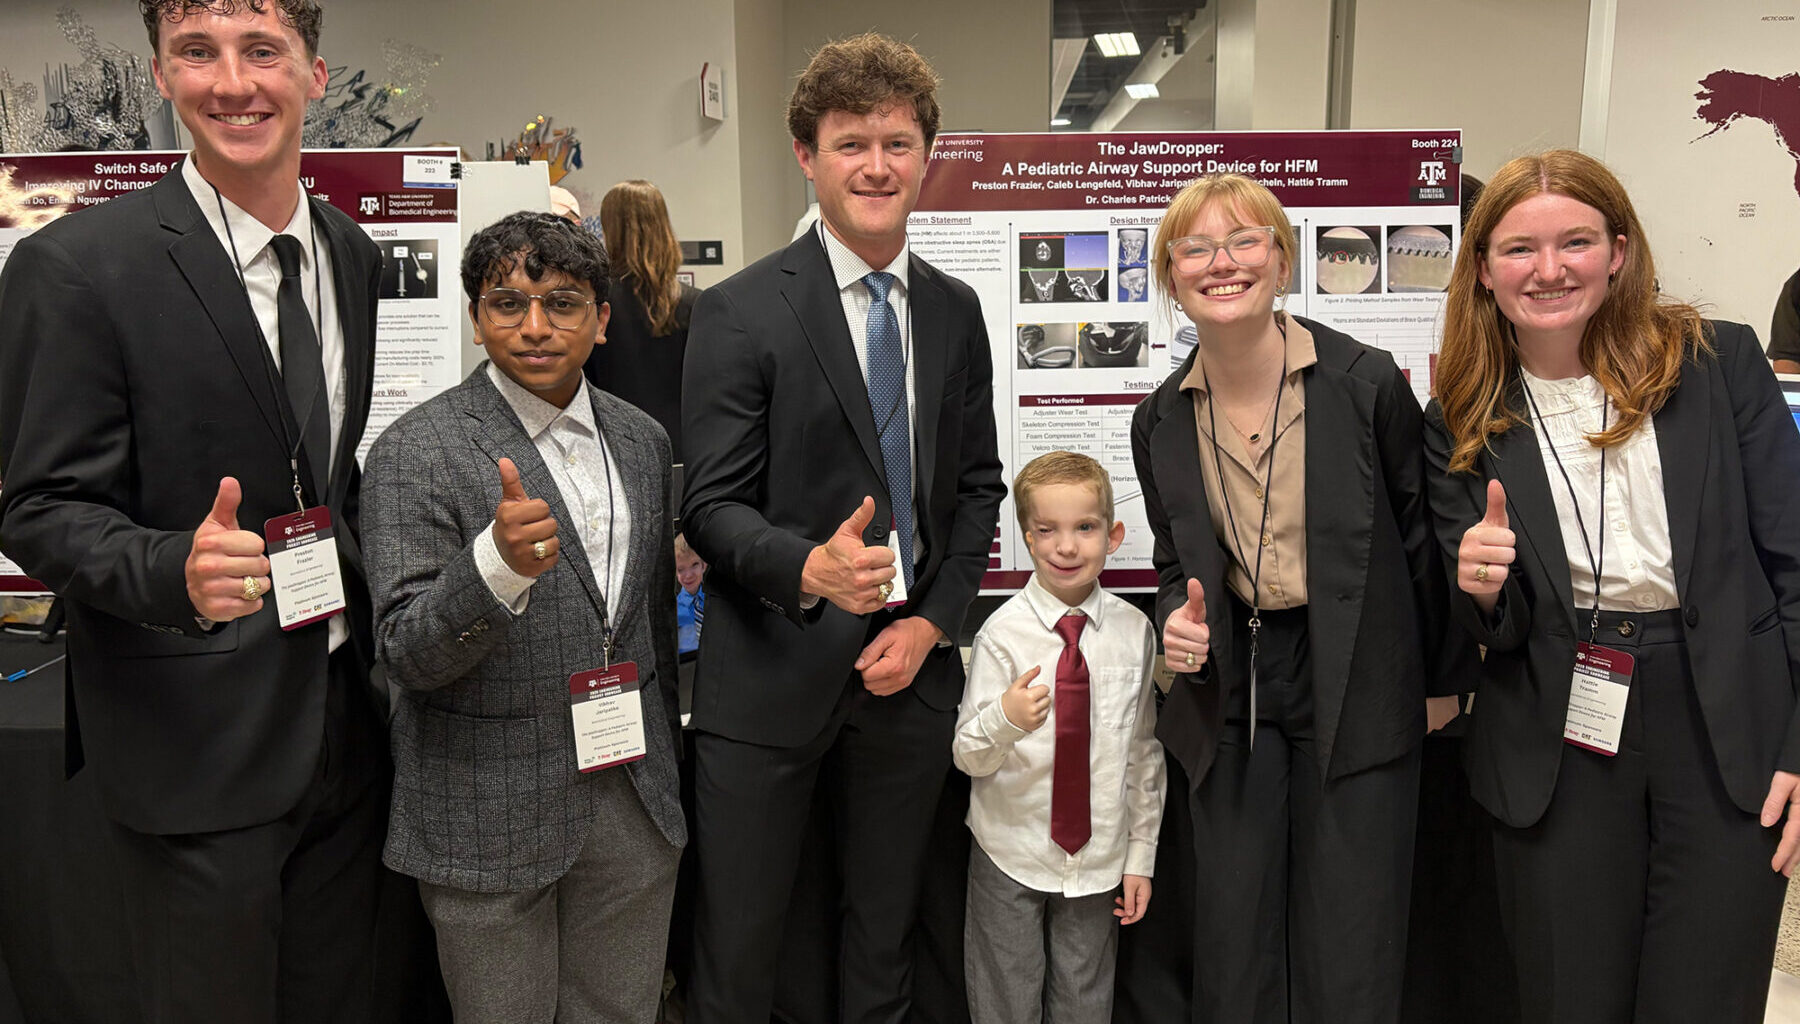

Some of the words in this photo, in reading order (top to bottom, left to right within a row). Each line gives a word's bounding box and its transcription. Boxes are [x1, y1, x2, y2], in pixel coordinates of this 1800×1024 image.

[1412, 138, 1440, 148] Booth
[1441, 138, 1458, 148] 224
[930, 148, 984, 162] ineering
[1098, 142, 1126, 155] The
[1130, 142, 1224, 158] JawDropper:
[94, 162, 136, 174] Switch
[140, 162, 168, 174] Safe
[1002, 162, 1014, 176] A
[1018, 162, 1084, 176] Pediatric
[1087, 162, 1138, 178] Airway
[1142, 160, 1203, 178] Support
[1206, 160, 1256, 173] Device
[1260, 160, 1280, 173] for
[1285, 159, 1318, 173] HFM
[25, 180, 86, 194] Improving
[88, 180, 101, 190] IV
[104, 180, 158, 190] Change
[301, 176, 314, 188] U
[972, 180, 1008, 190] Preston
[1010, 180, 1044, 190] Frazier,
[1047, 180, 1073, 189] Caleb
[1076, 180, 1124, 191] Lengefeld,
[1126, 179, 1158, 188] Vibhav
[1159, 178, 1195, 189] Jaripat
[1257, 178, 1284, 188] chein,
[1288, 178, 1314, 186] Hattie
[1316, 178, 1348, 186] Tramm
[389, 200, 426, 208] Department
[1086, 196, 1099, 204] Dr.
[1102, 195, 1136, 204] Charles
[423, 208, 458, 216] Engineering
[907, 216, 928, 224] blem
[930, 216, 972, 224] Statement
[1110, 216, 1138, 226] Design
[1140, 216, 1164, 224] Iterat
[372, 229, 398, 238] Impact
[1123, 381, 1154, 389] Testing
[387, 389, 407, 397] Work
